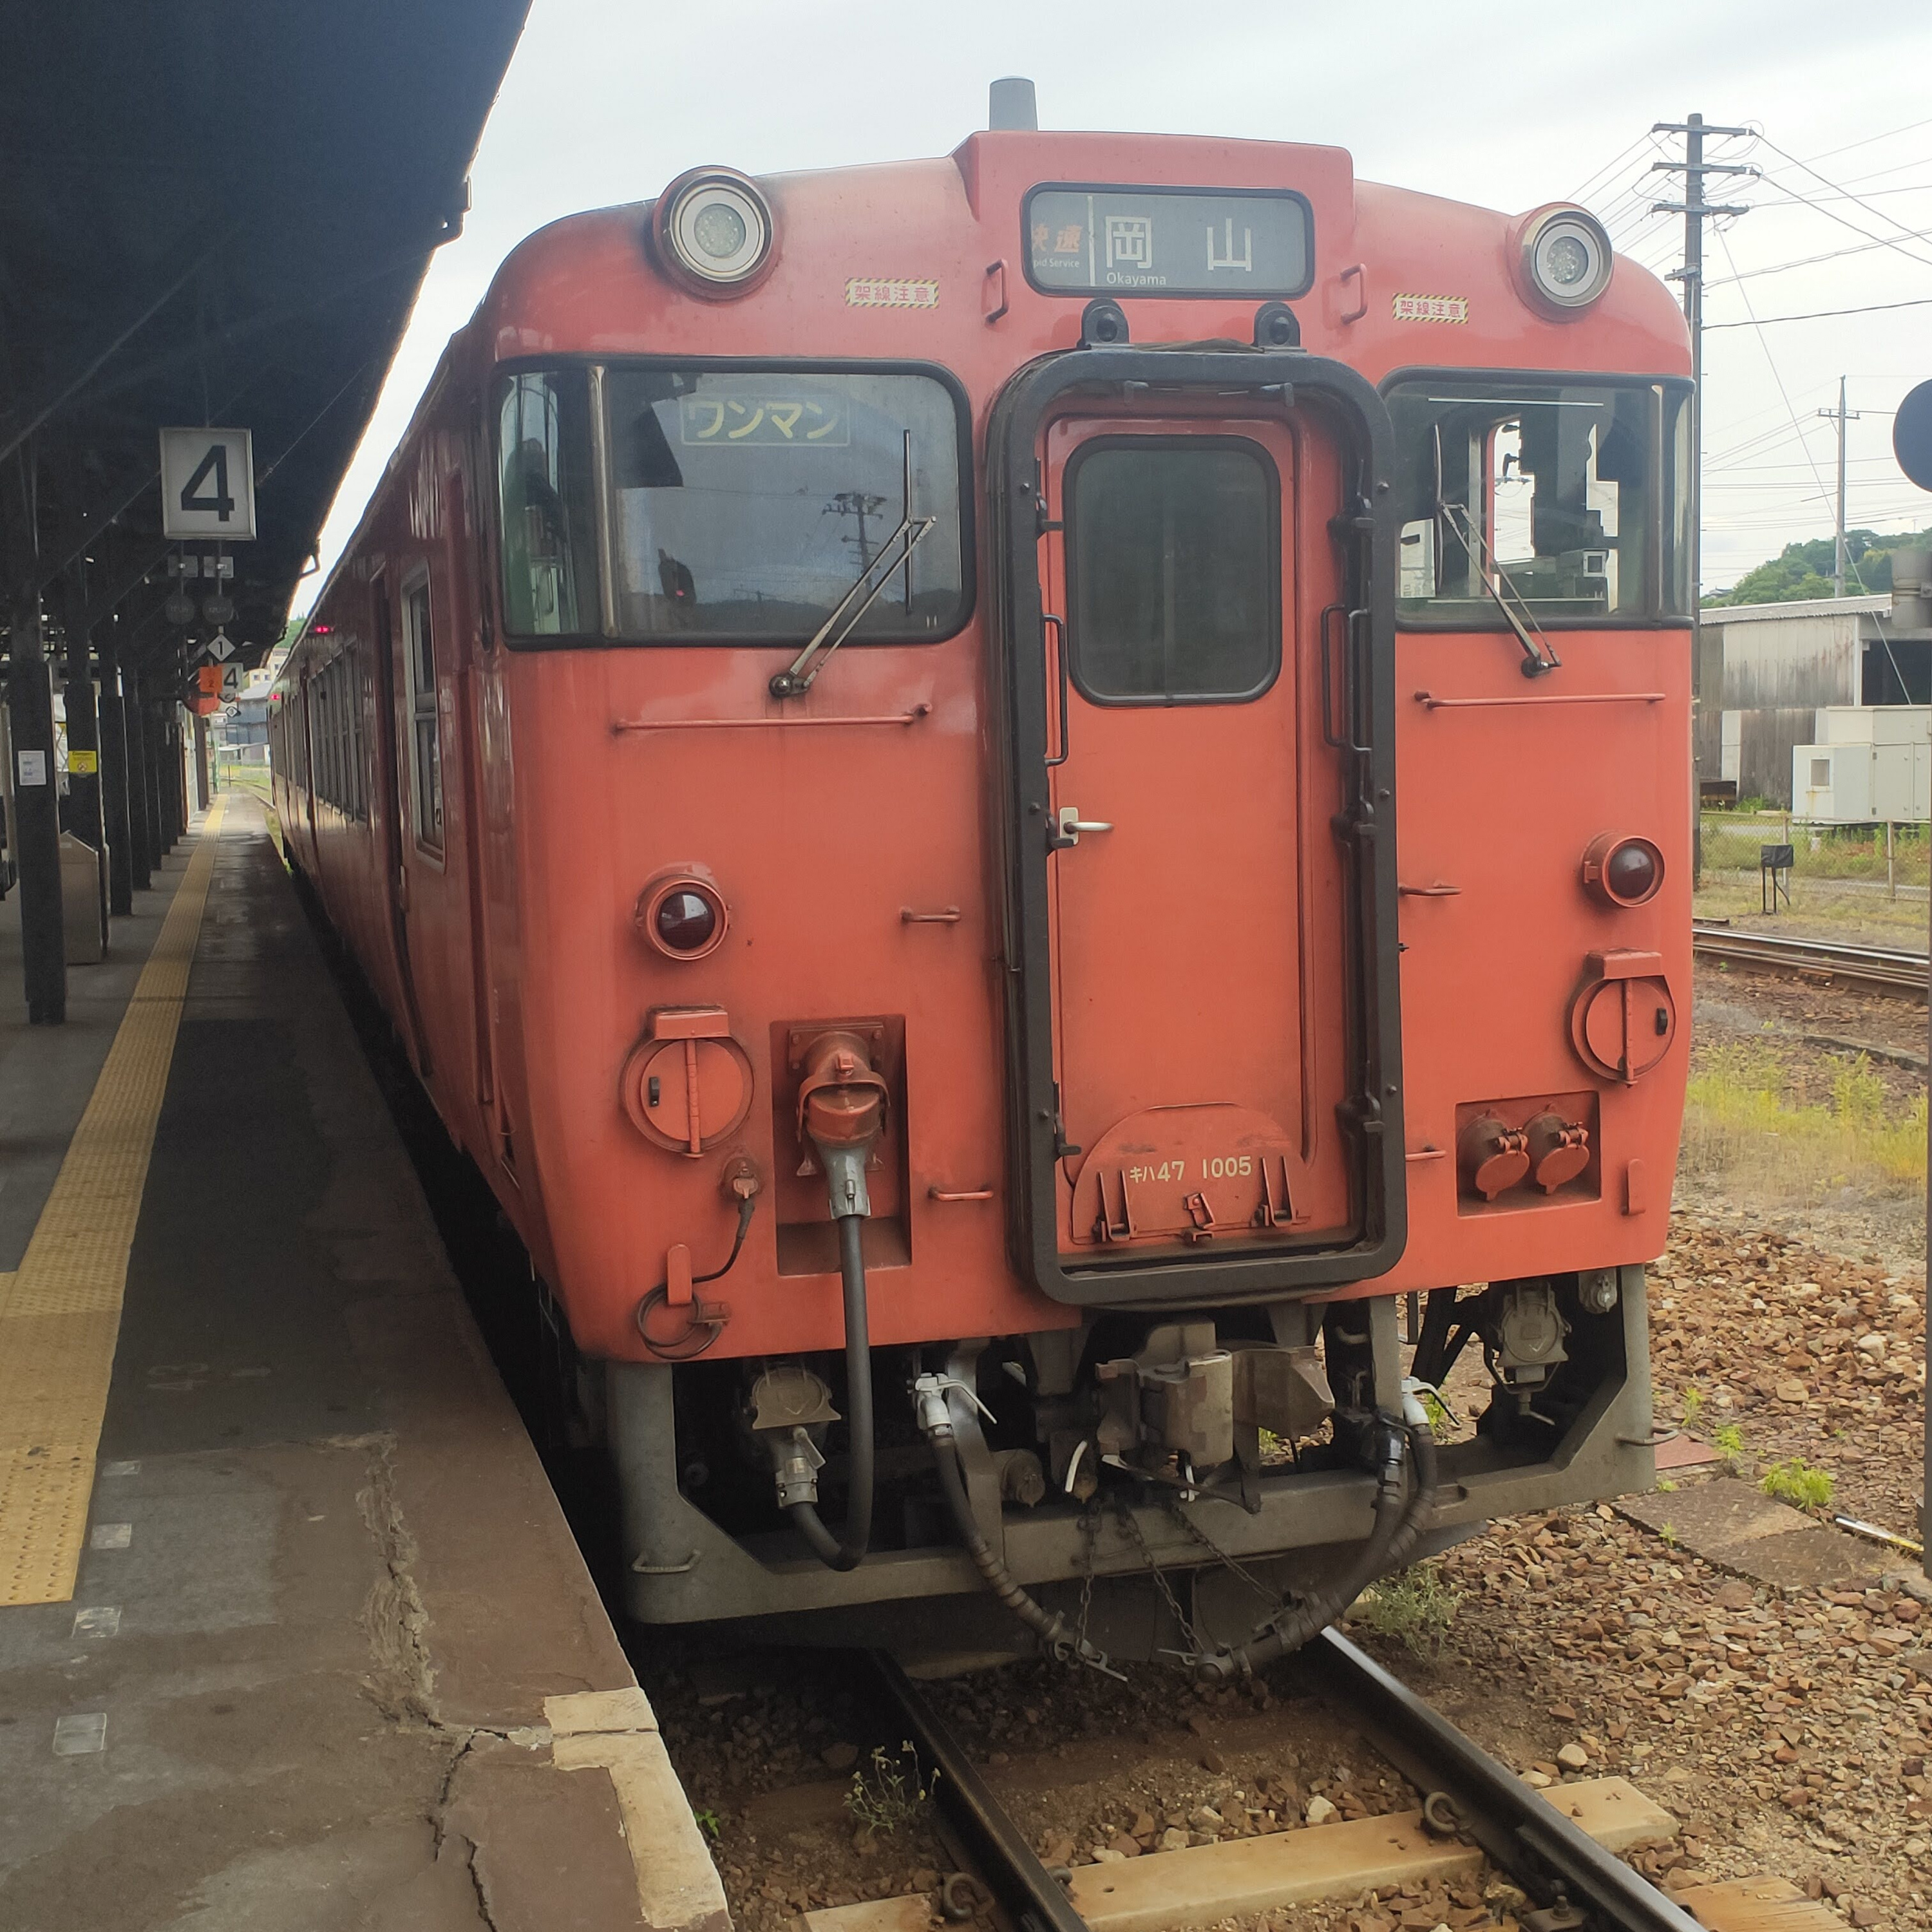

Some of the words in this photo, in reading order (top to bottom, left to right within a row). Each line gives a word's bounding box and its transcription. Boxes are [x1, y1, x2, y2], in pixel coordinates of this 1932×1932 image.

[1105, 216, 1252, 272] 岡山
[1050, 259, 1080, 268] Service
[1106, 272, 1167, 287] Okayama
[855, 285, 930, 302] 架線注意
[1400, 300, 1461, 318] 架線注意
[688, 400, 838, 439] ワンマン
[181, 445, 235, 522] 4
[218, 641, 223, 656] 1
[223, 667, 239, 689] 4
[1130, 1160, 1185, 1183] キハ47
[1202, 1156, 1251, 1179] 1005
